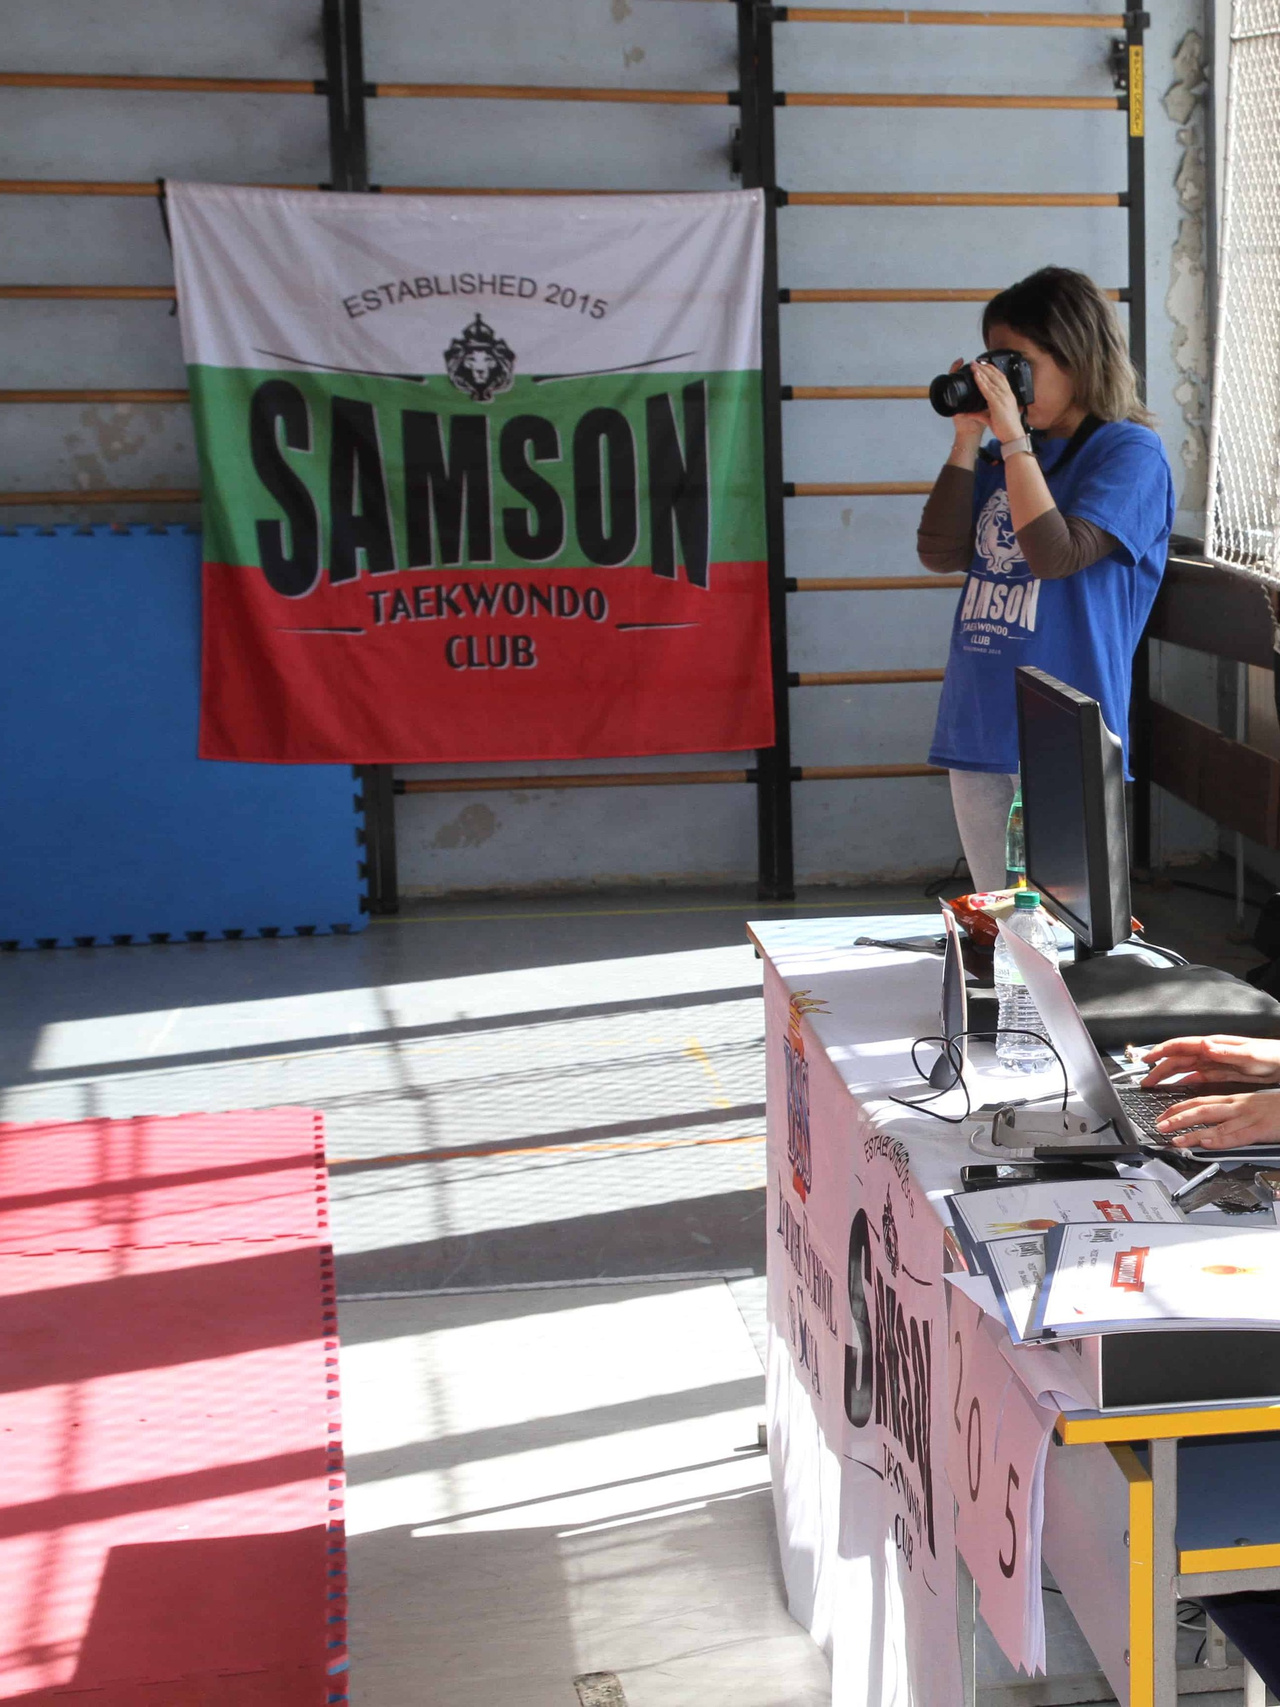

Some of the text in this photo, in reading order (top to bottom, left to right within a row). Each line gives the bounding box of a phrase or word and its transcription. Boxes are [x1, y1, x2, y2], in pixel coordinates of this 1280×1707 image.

[342, 273, 609, 320] ESTABLISHED 2015
[250, 379, 710, 598] SAMSON
[366, 582, 609, 625] TAEKWONDO
[961, 576, 1041, 633] AMSON
[445, 634, 538, 670] CLUB
